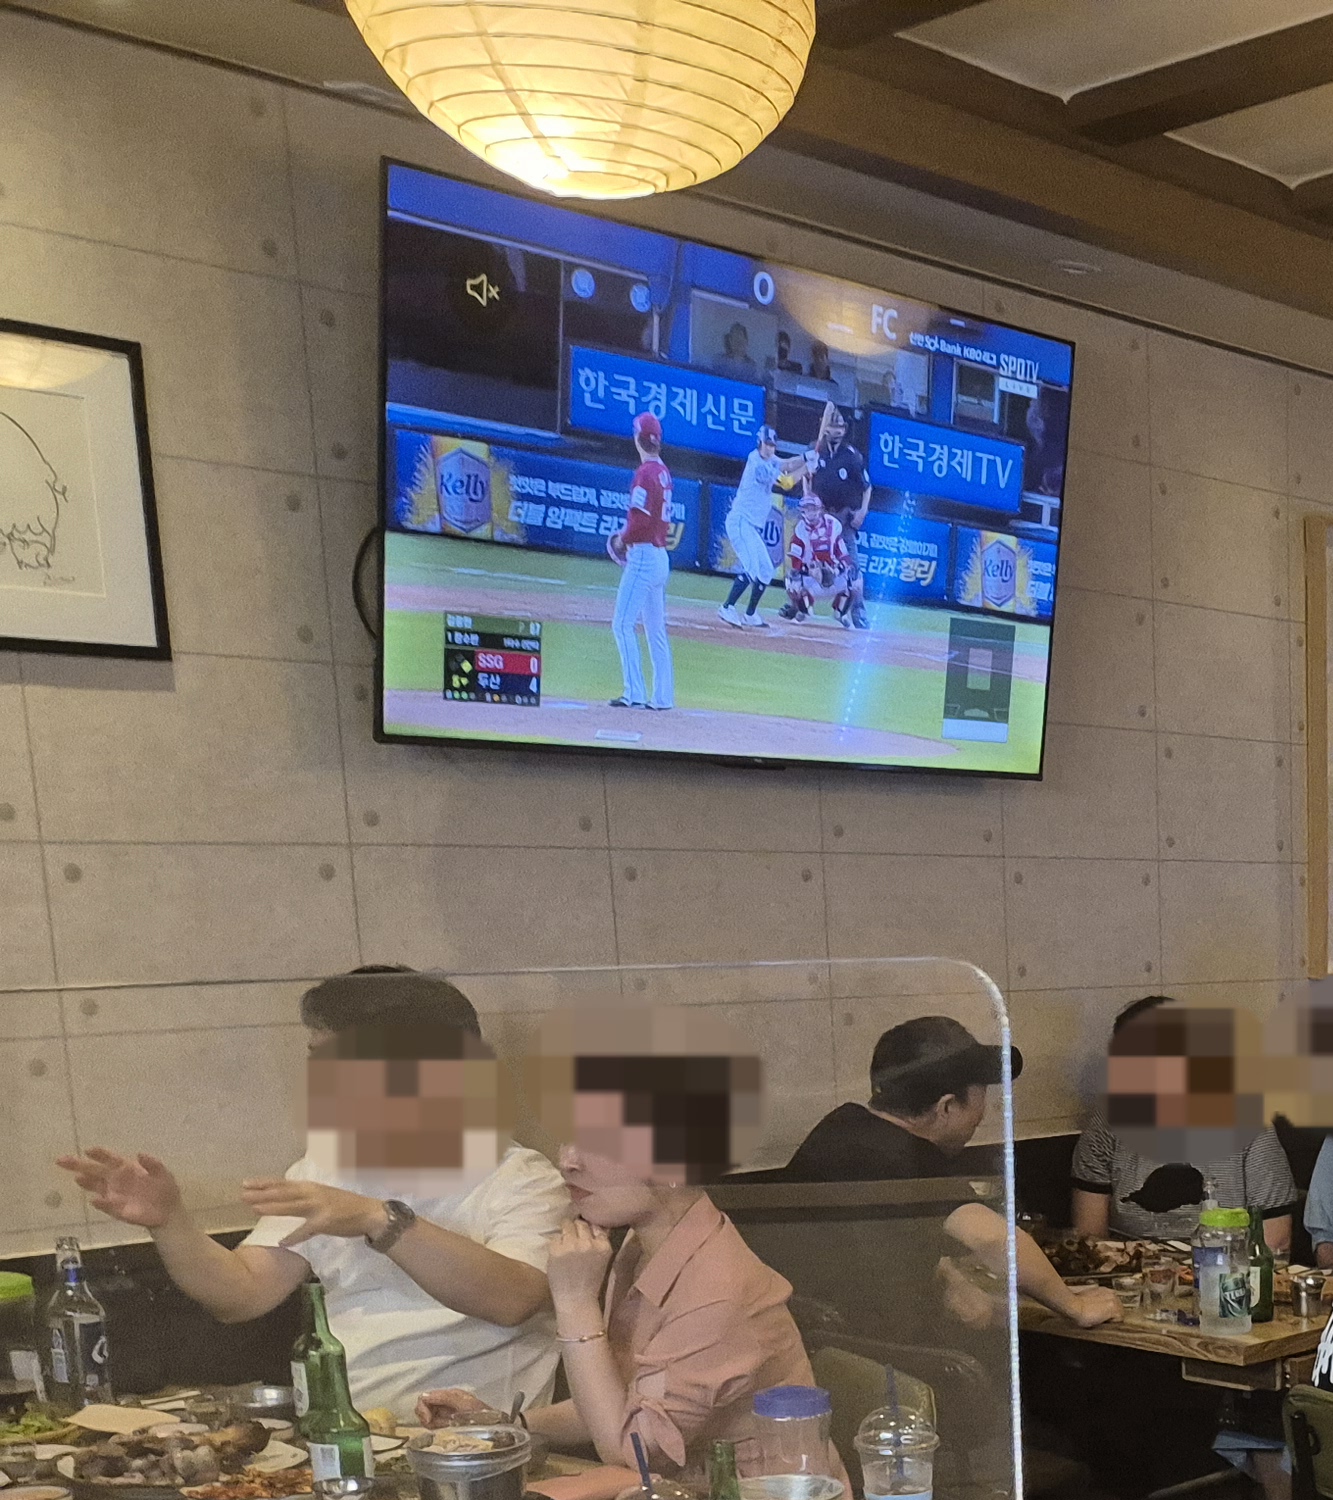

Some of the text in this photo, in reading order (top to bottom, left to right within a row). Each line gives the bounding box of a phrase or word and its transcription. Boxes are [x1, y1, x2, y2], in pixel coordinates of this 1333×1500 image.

[940, 339, 962, 356] Bank
[964, 346, 982, 363] KBO
[1000, 353, 1039, 383] SPOTV
[578, 366, 756, 436] 한국경제신문
[879, 431, 1013, 489] 한국경제TV
[439, 472, 488, 503] Kelly
[983, 559, 1013, 583] Kelly
[477, 652, 538, 674] SSG 0
[477, 672, 501, 690] 두산
